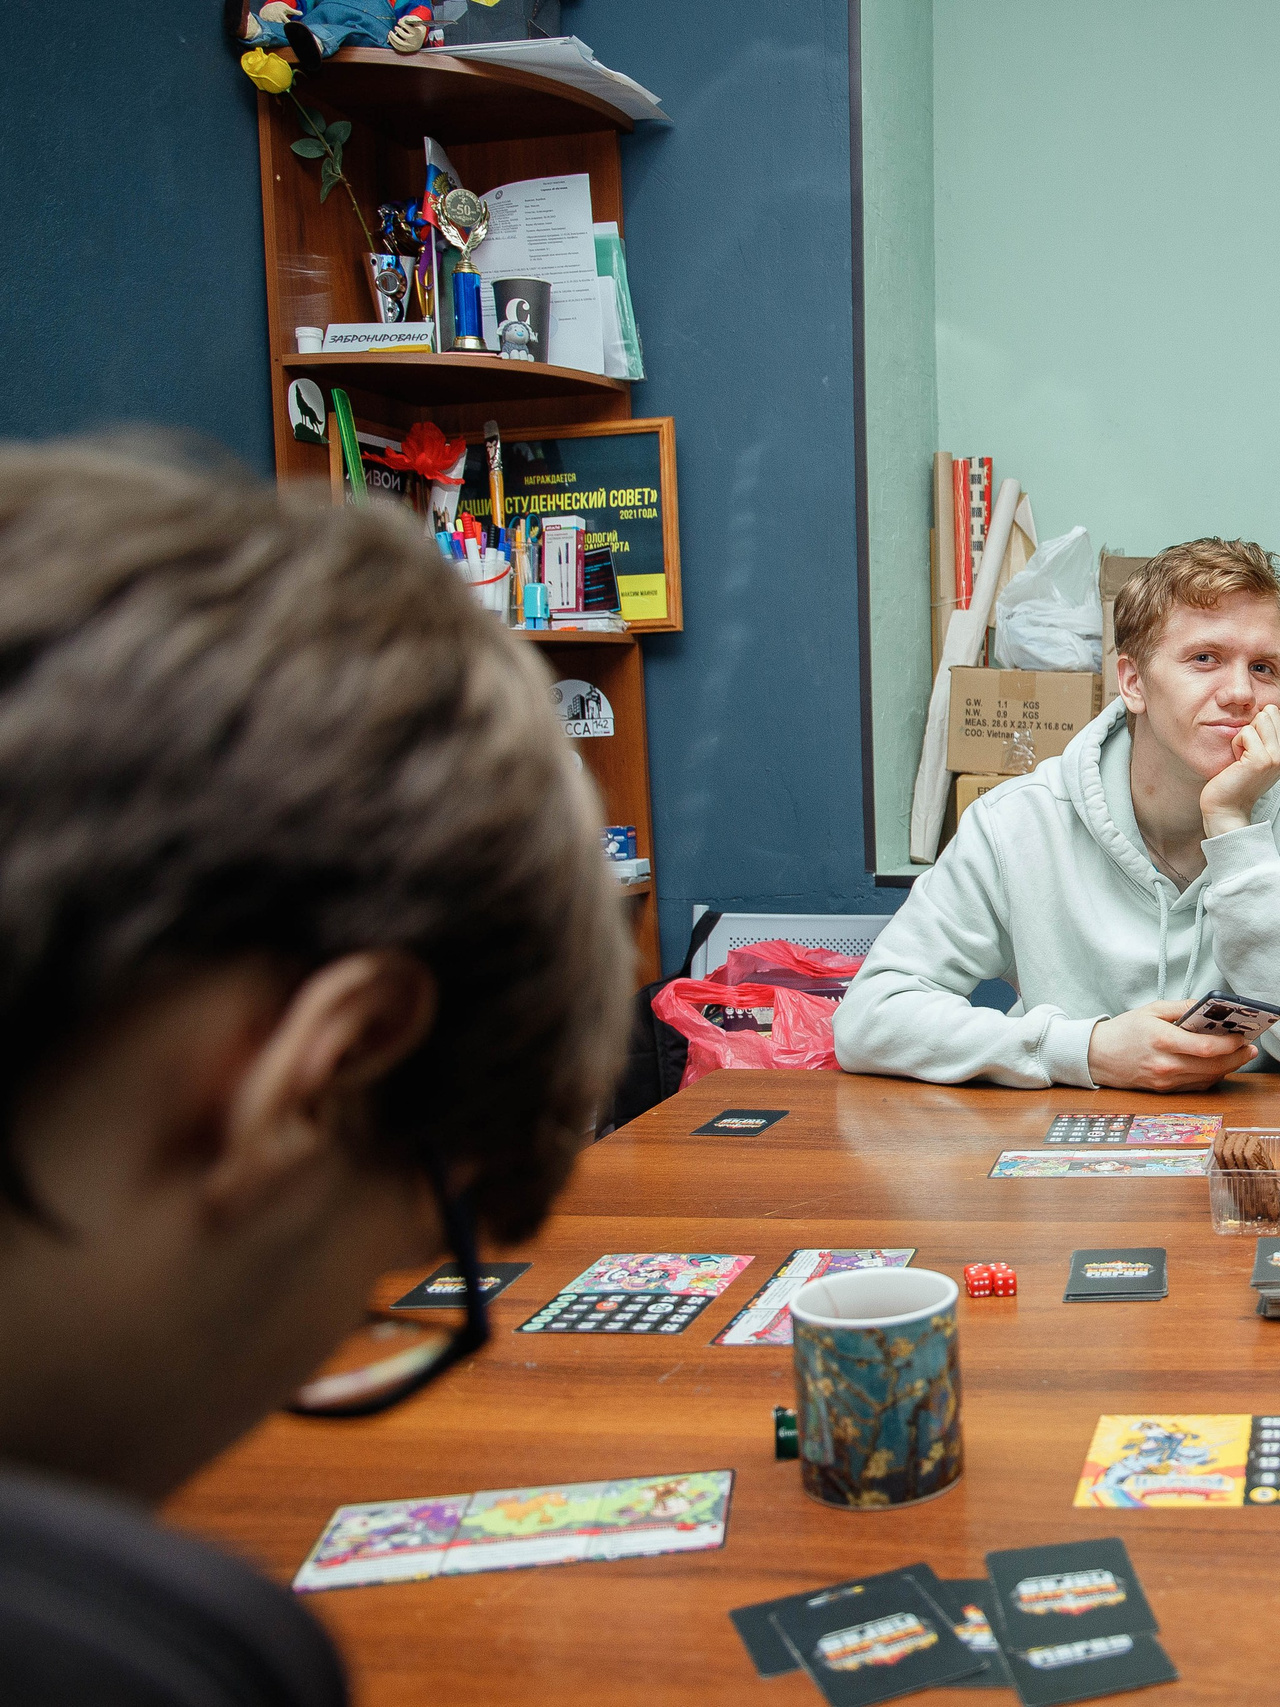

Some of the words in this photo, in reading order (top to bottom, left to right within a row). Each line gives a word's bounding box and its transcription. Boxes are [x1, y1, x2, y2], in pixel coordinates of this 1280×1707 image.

[328, 333, 429, 344] ЗАБРОНИРОВАНО
[346, 468, 401, 491] ИВОЙ
[524, 472, 577, 486] НАГРАЖДАЕТСЯ
[457, 498, 493, 517] УЧШИ
[505, 487, 606, 515] СТУДЕНЧЕСКИЙ
[609, 487, 658, 508] СОВЕТ»
[619, 510, 636, 520] 2021
[637, 508, 658, 520] ГОДА
[965, 698, 983, 707] G.W.
[997, 700, 1008, 708] 1.1
[1023, 701, 1040, 710] KGS
[965, 708, 982, 717] N.W.
[996, 710, 1008, 718] 0.9
[1022, 711, 1040, 719] KGS
[593, 719, 609, 729] 142
[964, 718, 989, 727] MEAS.
[991, 719, 1008, 728] 28.6
[1010, 720, 1016, 728] X
[1017, 721, 1034, 730] 23.7
[1036, 722, 1042, 730] X
[1044, 722, 1060, 731] 16.8
[1061, 722, 1074, 731] CM
[964, 729, 985, 738] COO:
